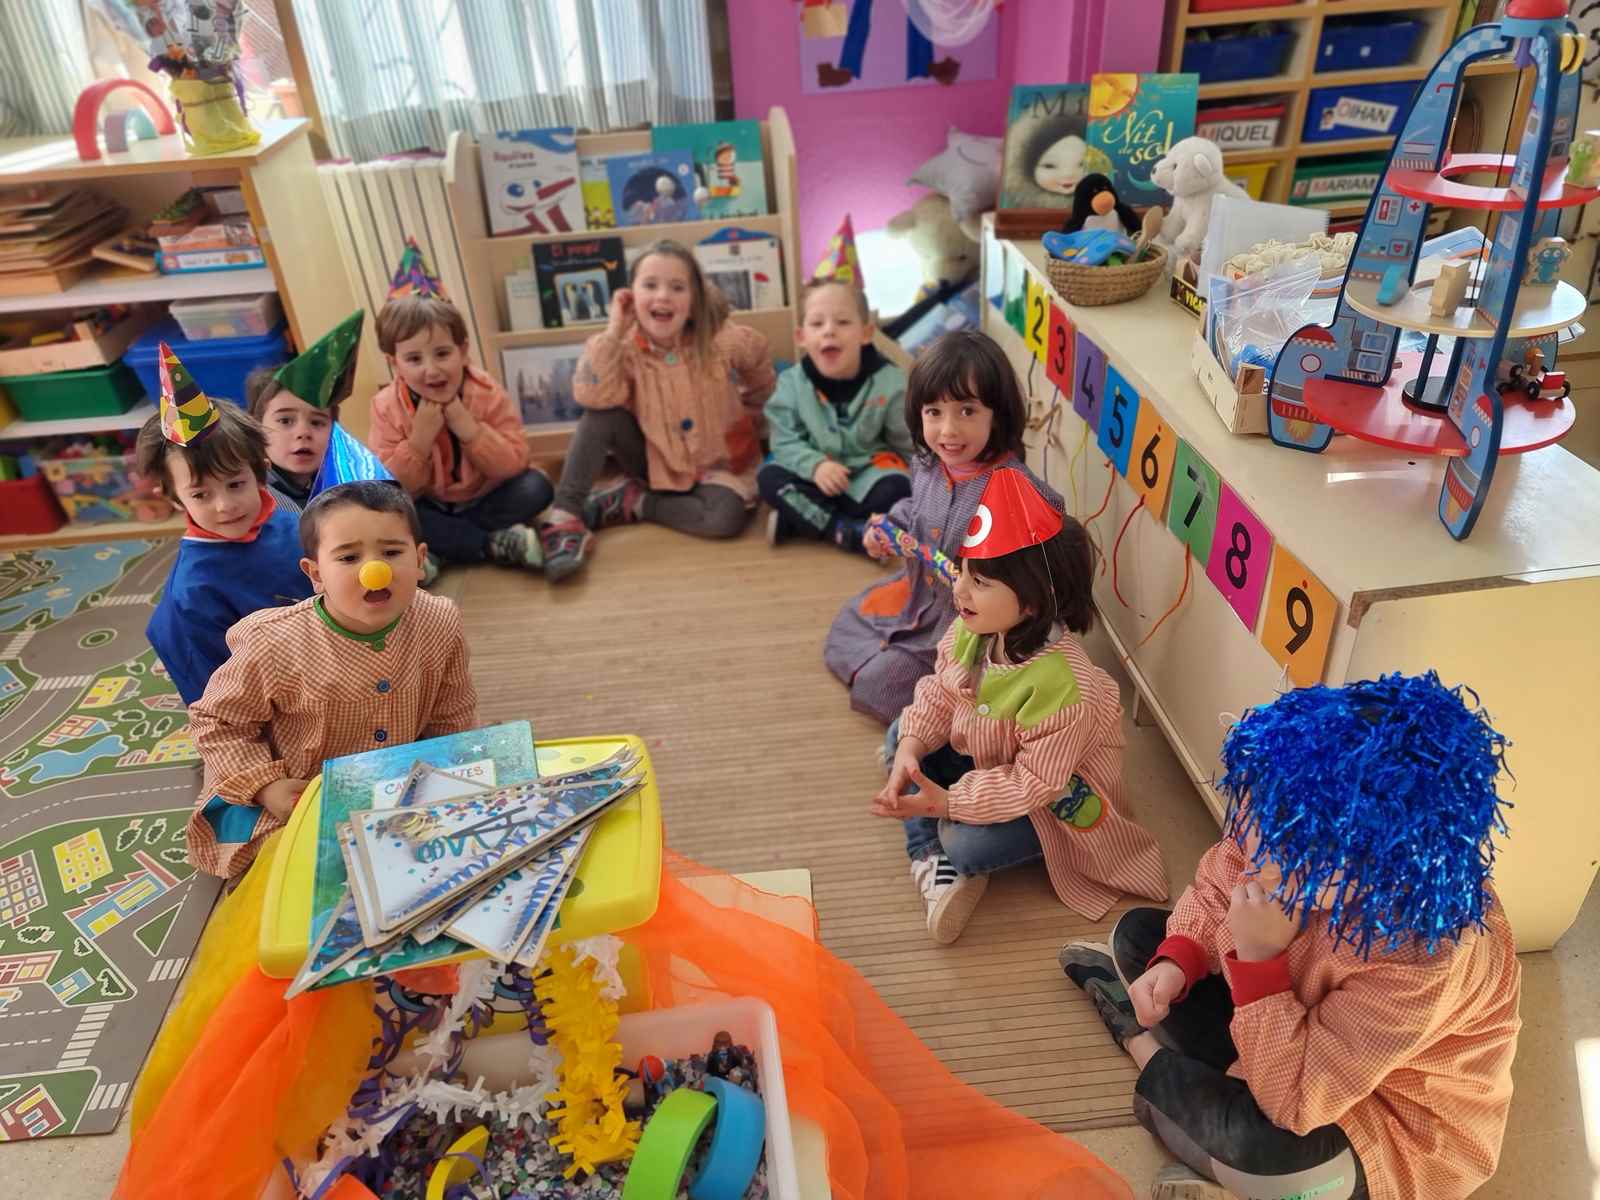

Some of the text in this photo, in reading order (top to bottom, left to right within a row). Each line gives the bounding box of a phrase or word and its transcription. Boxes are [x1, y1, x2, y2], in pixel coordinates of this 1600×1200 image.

[1336, 99, 1390, 124] OIHAN
[1103, 110, 1164, 144] Nit
[1199, 123, 1273, 143] MIQUEL
[1129, 121, 1174, 165] sol
[1311, 174, 1376, 194] MARIAM
[1032, 295, 1314, 656] 2 3 4 5 6 7 8 9
